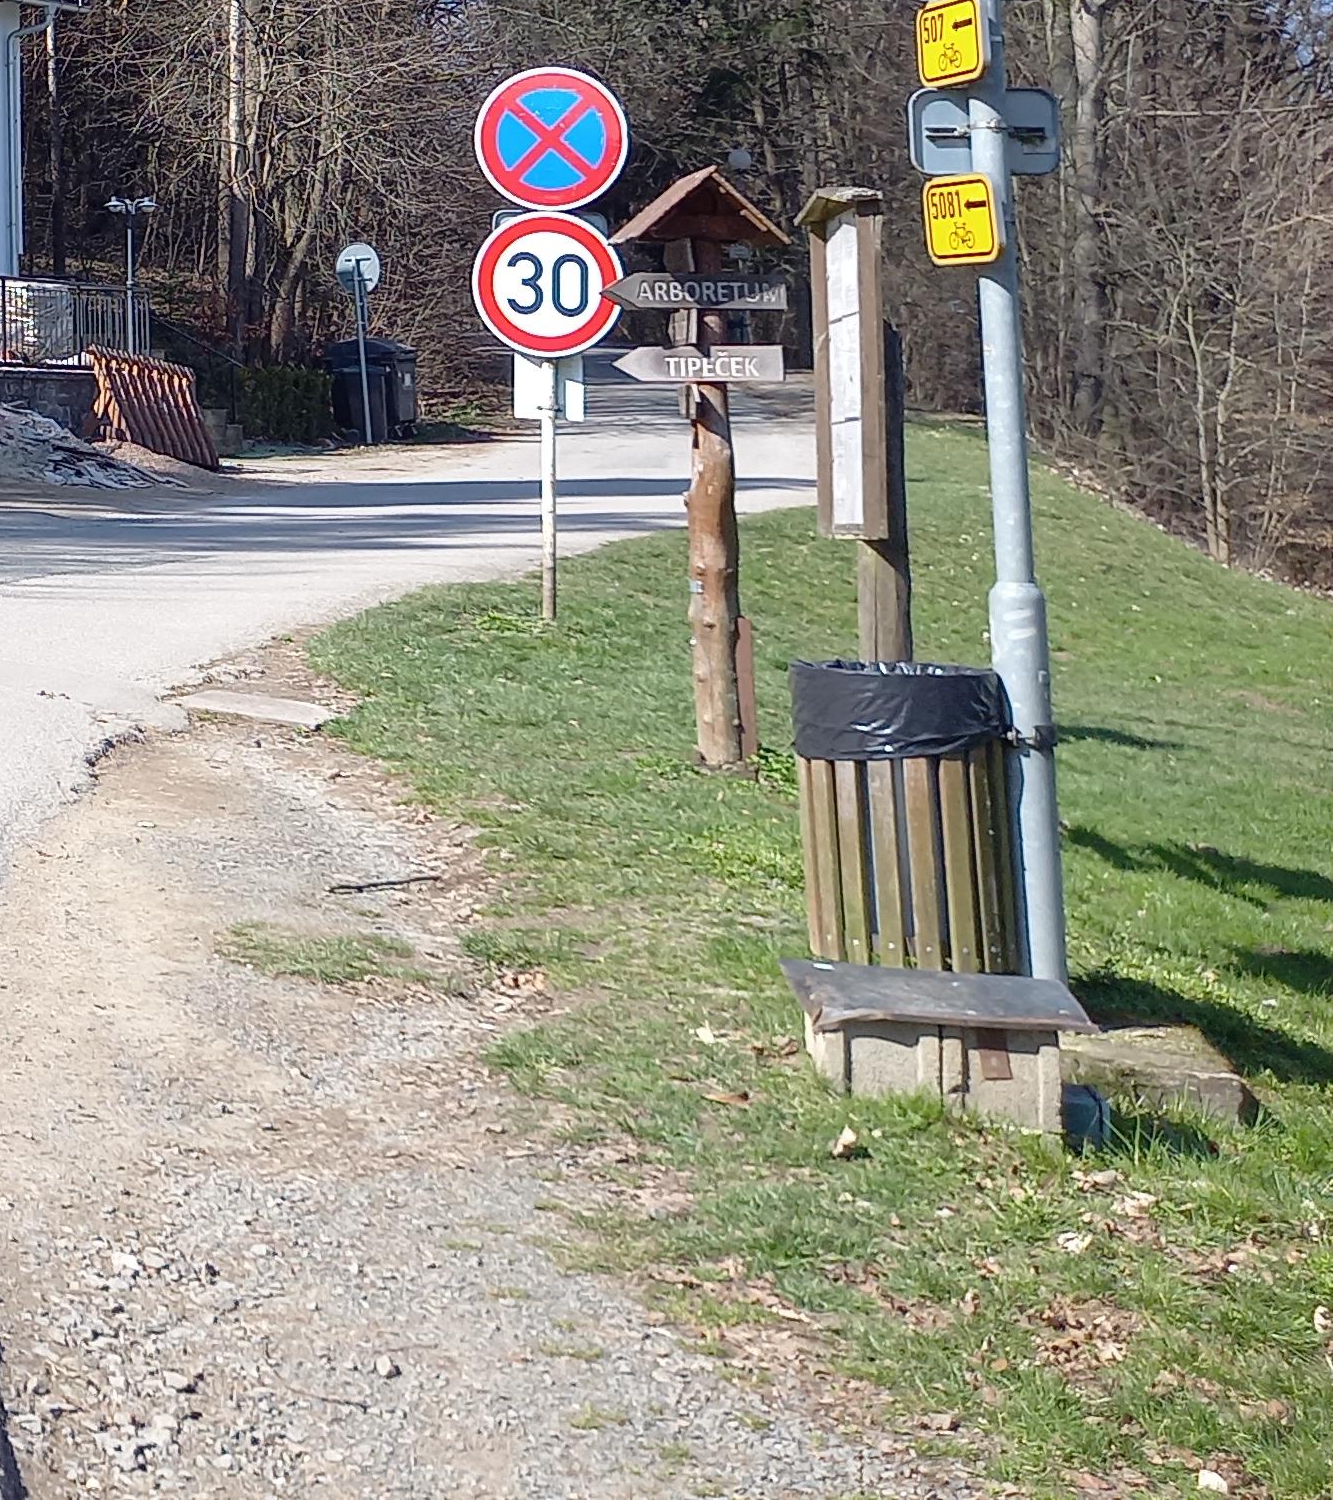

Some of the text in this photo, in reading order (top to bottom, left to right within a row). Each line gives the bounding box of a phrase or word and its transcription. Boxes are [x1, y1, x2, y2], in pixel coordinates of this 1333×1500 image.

[923, 13, 944, 44] 507
[930, 190, 963, 220] 5081
[507, 252, 589, 317] 30
[637, 281, 779, 303] ARBORETUM
[664, 351, 760, 378] TIPEČEK
